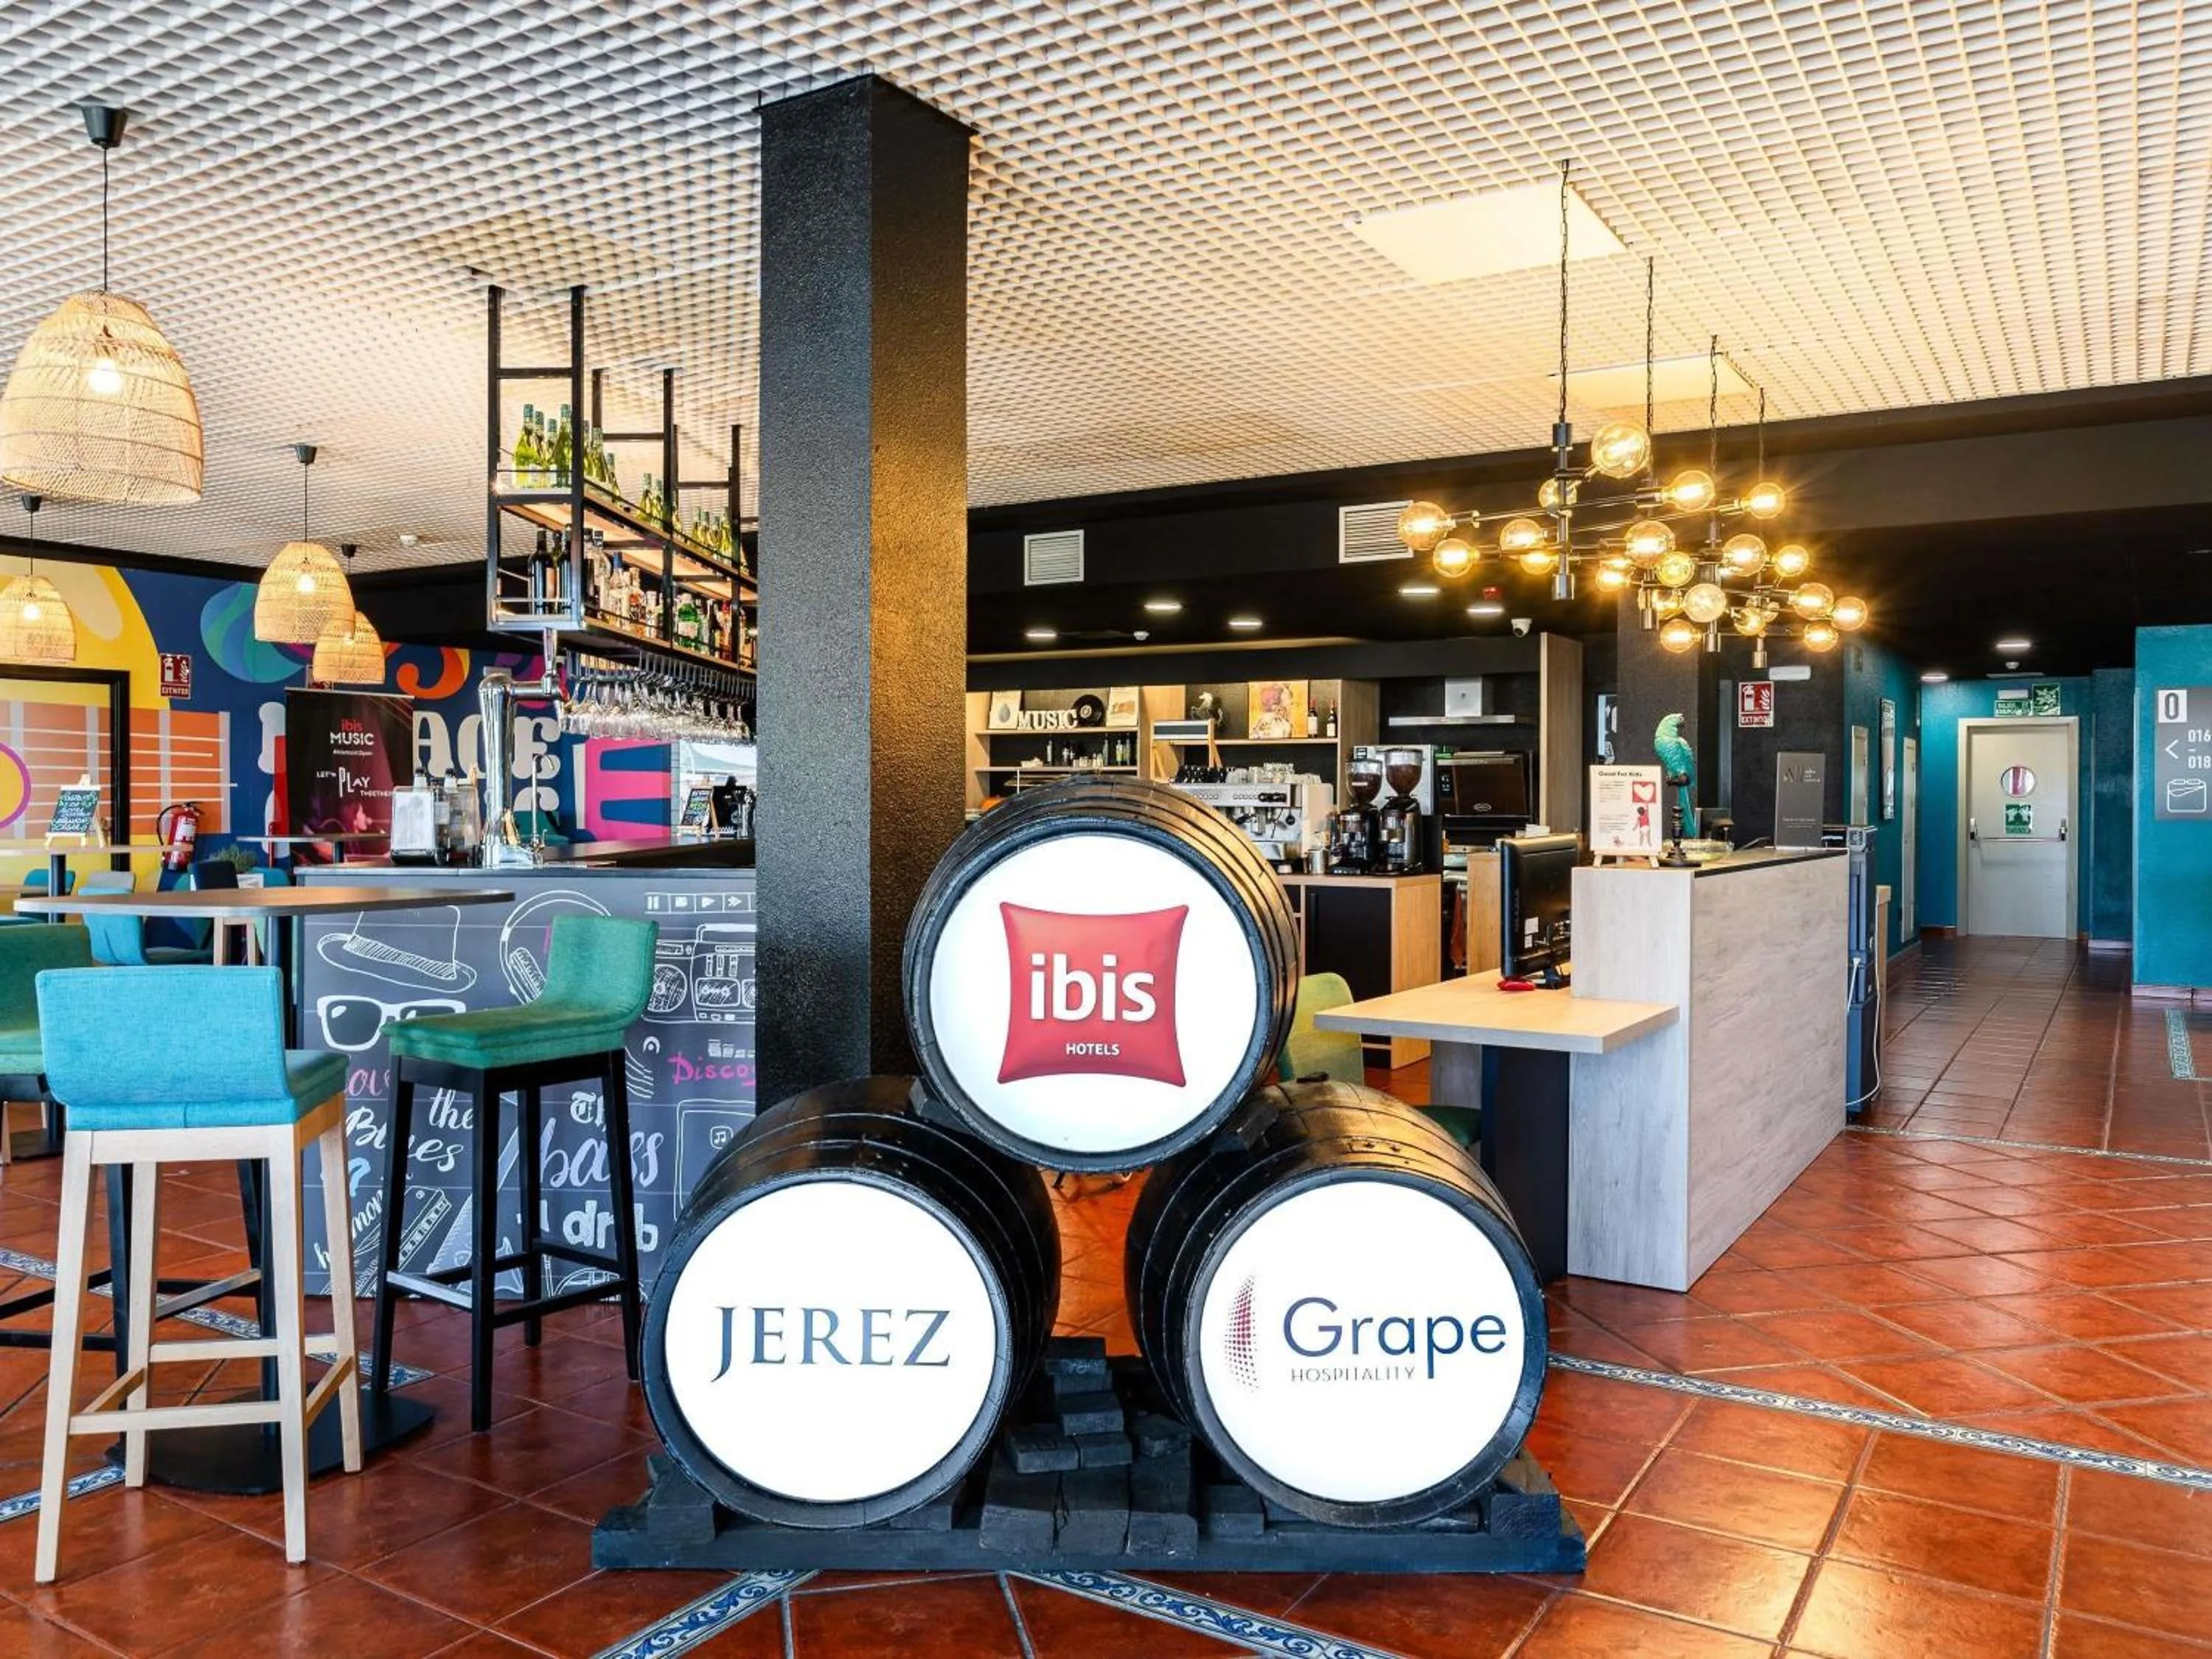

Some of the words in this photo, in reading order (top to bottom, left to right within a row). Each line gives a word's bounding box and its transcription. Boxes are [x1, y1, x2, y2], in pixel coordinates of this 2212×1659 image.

[2165, 692, 2179, 720] 0
[341, 719, 364, 731] ibis
[1018, 709, 1077, 730] MUSIC
[330, 731, 375, 745] MUSIC
[2188, 729, 2211, 742] 016
[2188, 756, 2211, 769] 018
[338, 766, 371, 798] PLAY
[1030, 952, 1157, 1023] ibis
[1065, 1043, 1120, 1056] HOTELS
[346, 1106, 464, 1172] Bles
[710, 1306, 951, 1382] JEREZ
[1283, 1297, 1507, 1380] Grape
[1291, 1366, 1415, 1382] HOSPITALITY
